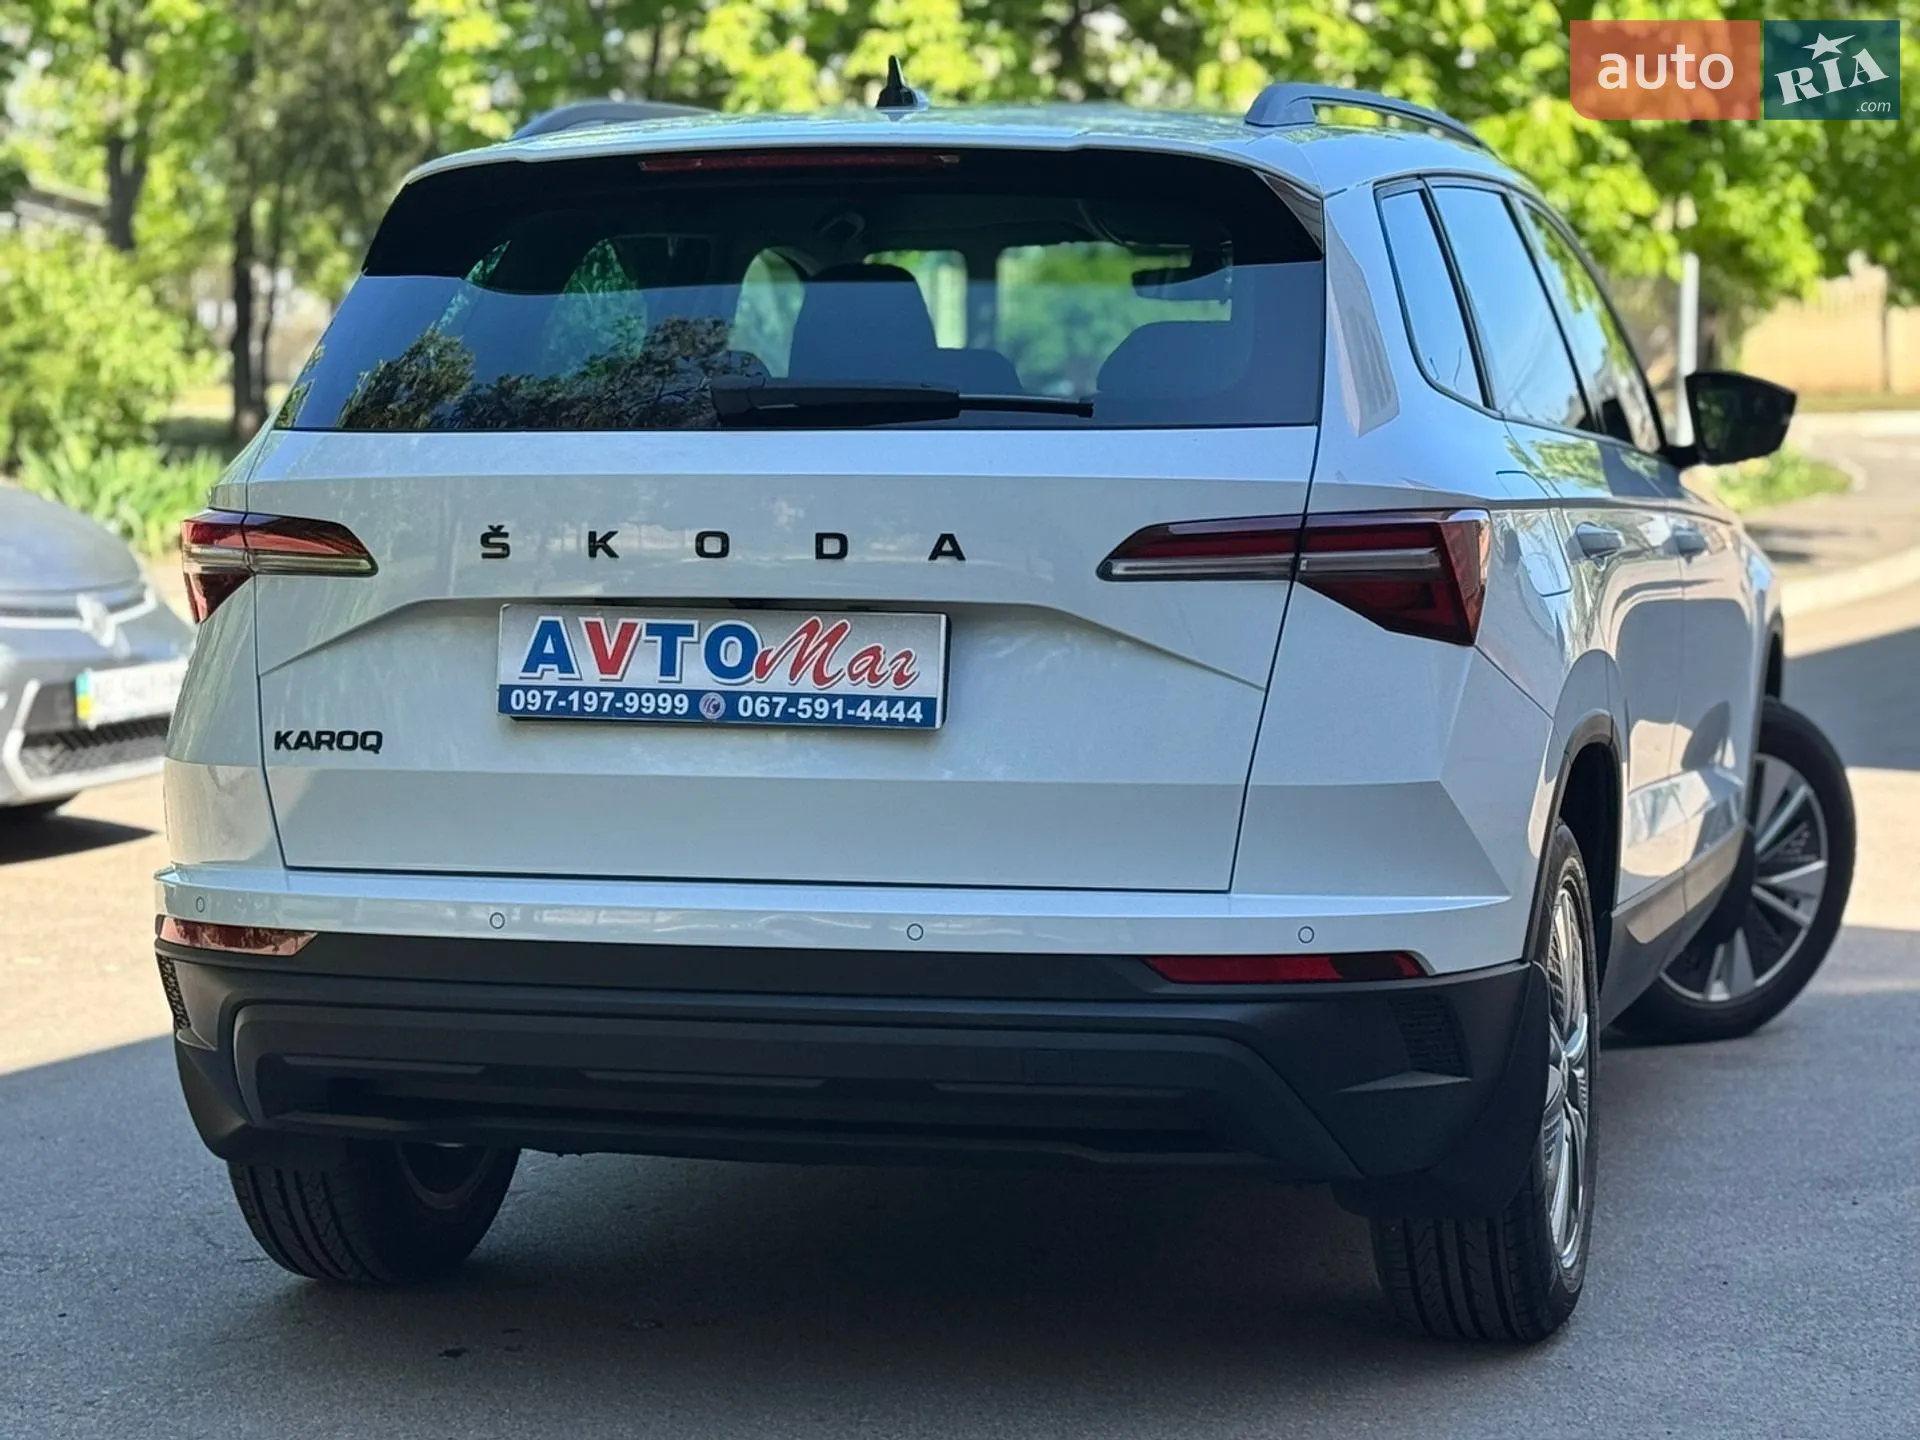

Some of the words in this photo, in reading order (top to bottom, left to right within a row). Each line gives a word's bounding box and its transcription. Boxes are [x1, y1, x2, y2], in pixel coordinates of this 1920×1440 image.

[480, 525, 966, 562] ŠKODA
[509, 689, 690, 716] 097-197-9999
[737, 696, 923, 724] 067-591-4444
[274, 730, 383, 754] KAROQ
